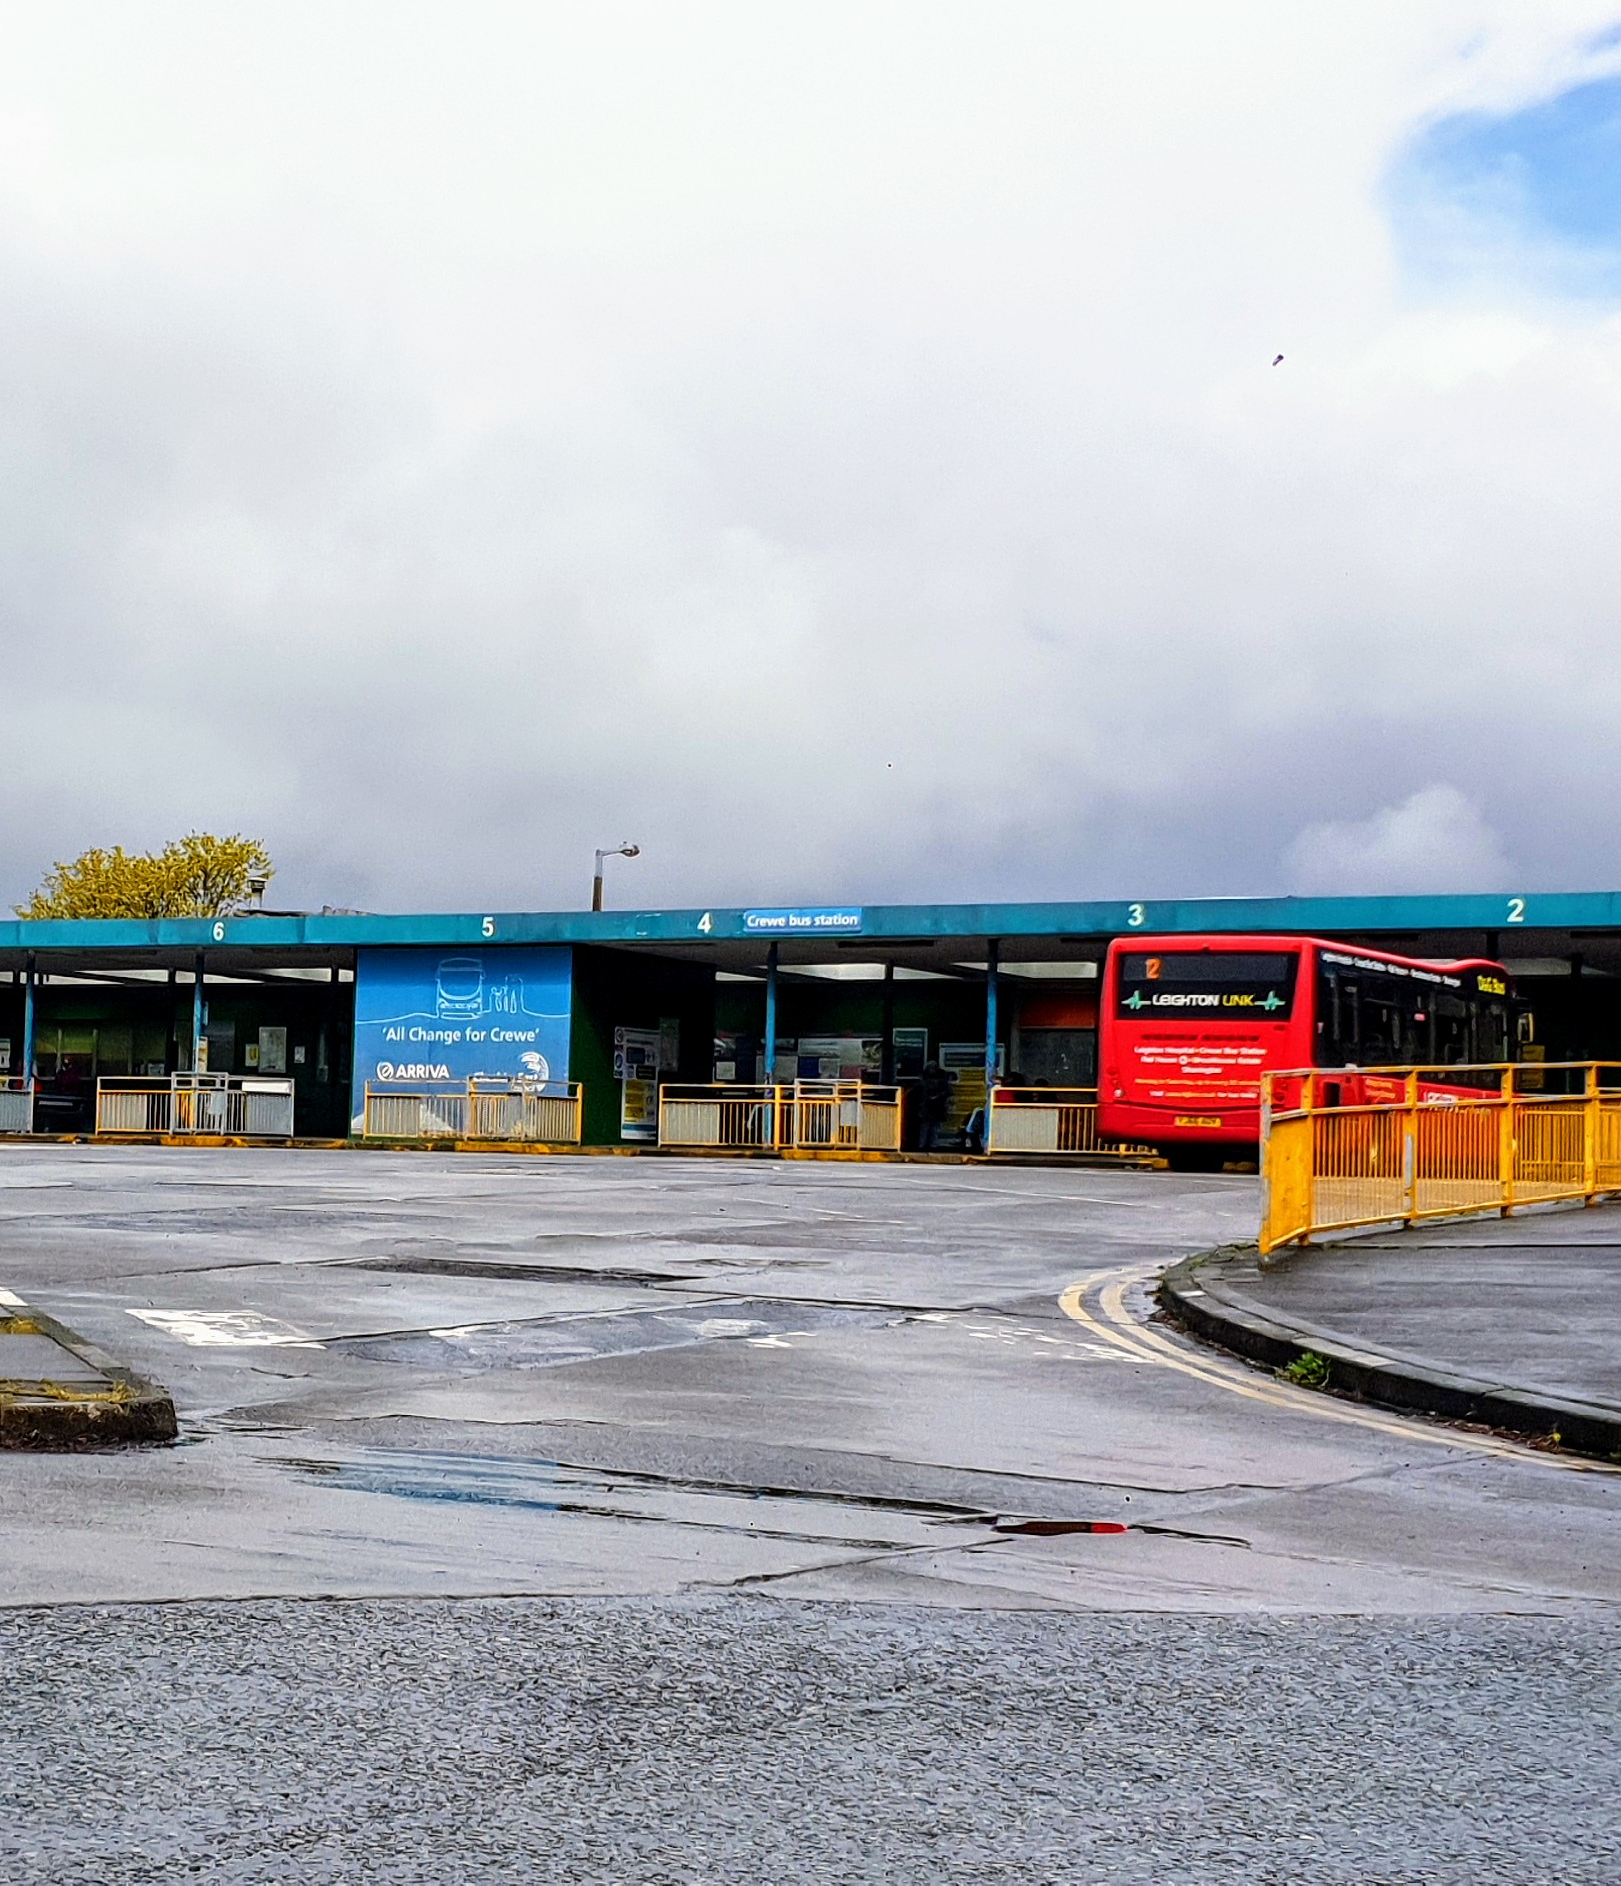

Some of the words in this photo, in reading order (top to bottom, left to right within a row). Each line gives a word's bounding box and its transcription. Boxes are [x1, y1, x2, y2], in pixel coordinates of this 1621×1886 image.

[1128, 903, 1144, 927] 3
[1507, 898, 1524, 922] 2
[481, 916, 494, 937] 5
[697, 911, 712, 934] 4
[747, 915, 786, 927] Crewe
[789, 914, 811, 927] bus
[813, 914, 858, 926] station
[213, 921, 224, 941] 6
[1152, 993, 1220, 1006] LEIGHTON
[1222, 993, 1256, 1006] LINK
[409, 1026, 460, 1044] Change
[465, 1026, 487, 1042] for
[395, 1063, 450, 1079] ARRIVA
